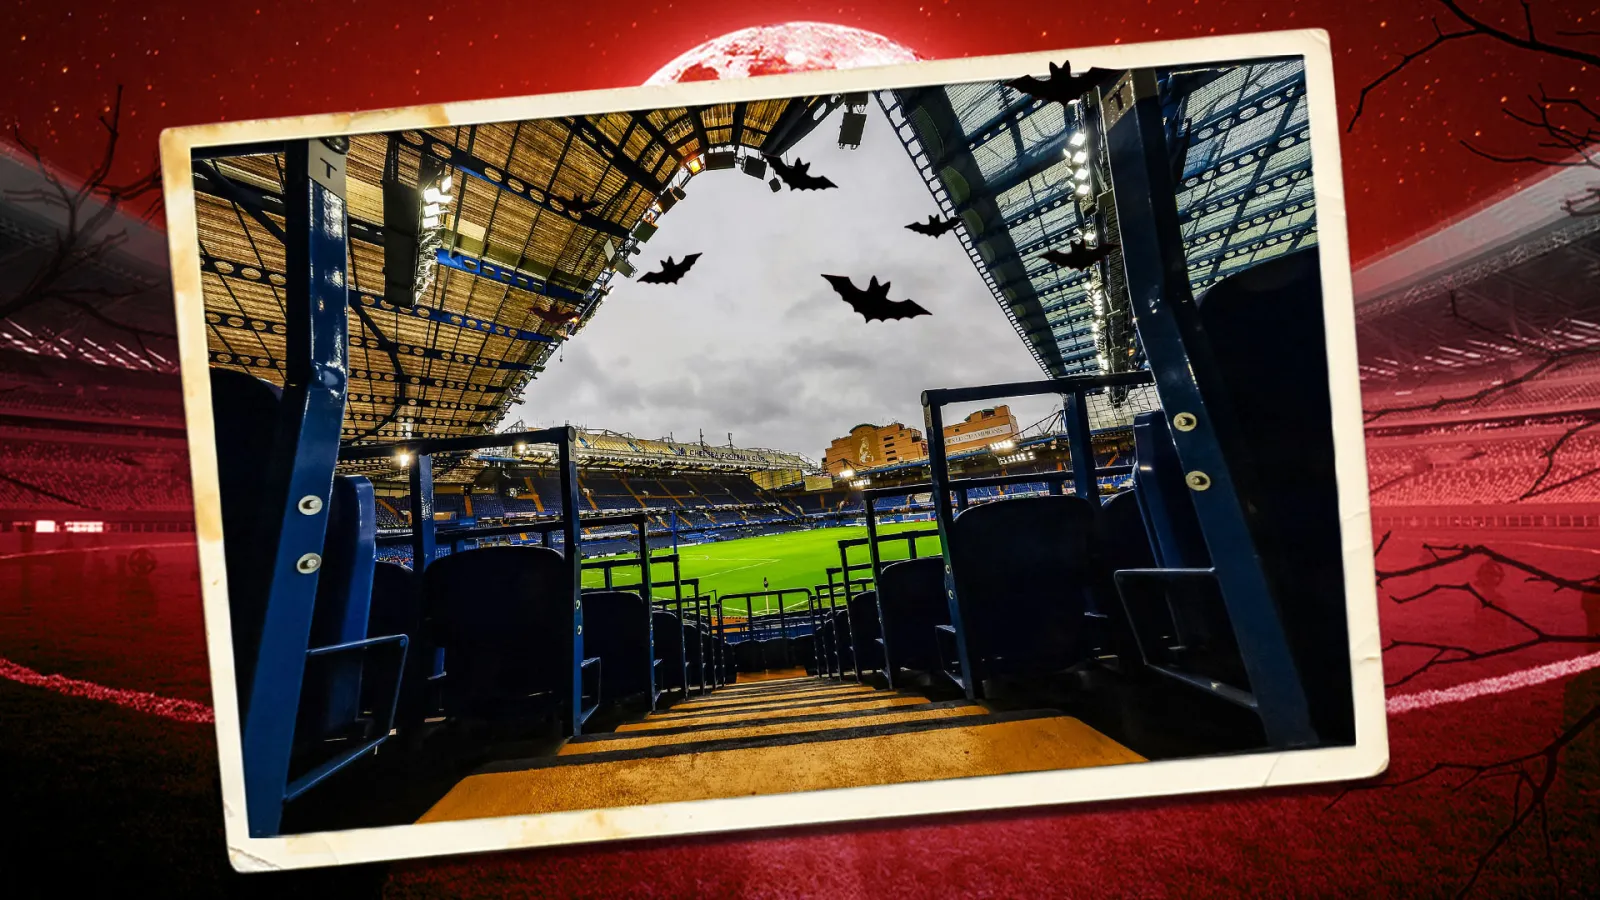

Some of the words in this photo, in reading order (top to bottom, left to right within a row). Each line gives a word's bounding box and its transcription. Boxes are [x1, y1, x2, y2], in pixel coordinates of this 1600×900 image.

[1108, 81, 1127, 111] T
[319, 157, 338, 179] T
[964, 428, 1003, 439] CHAMPIONS
[689, 449, 719, 459] CHELSEA
[721, 452, 750, 461] FOOTBALL
